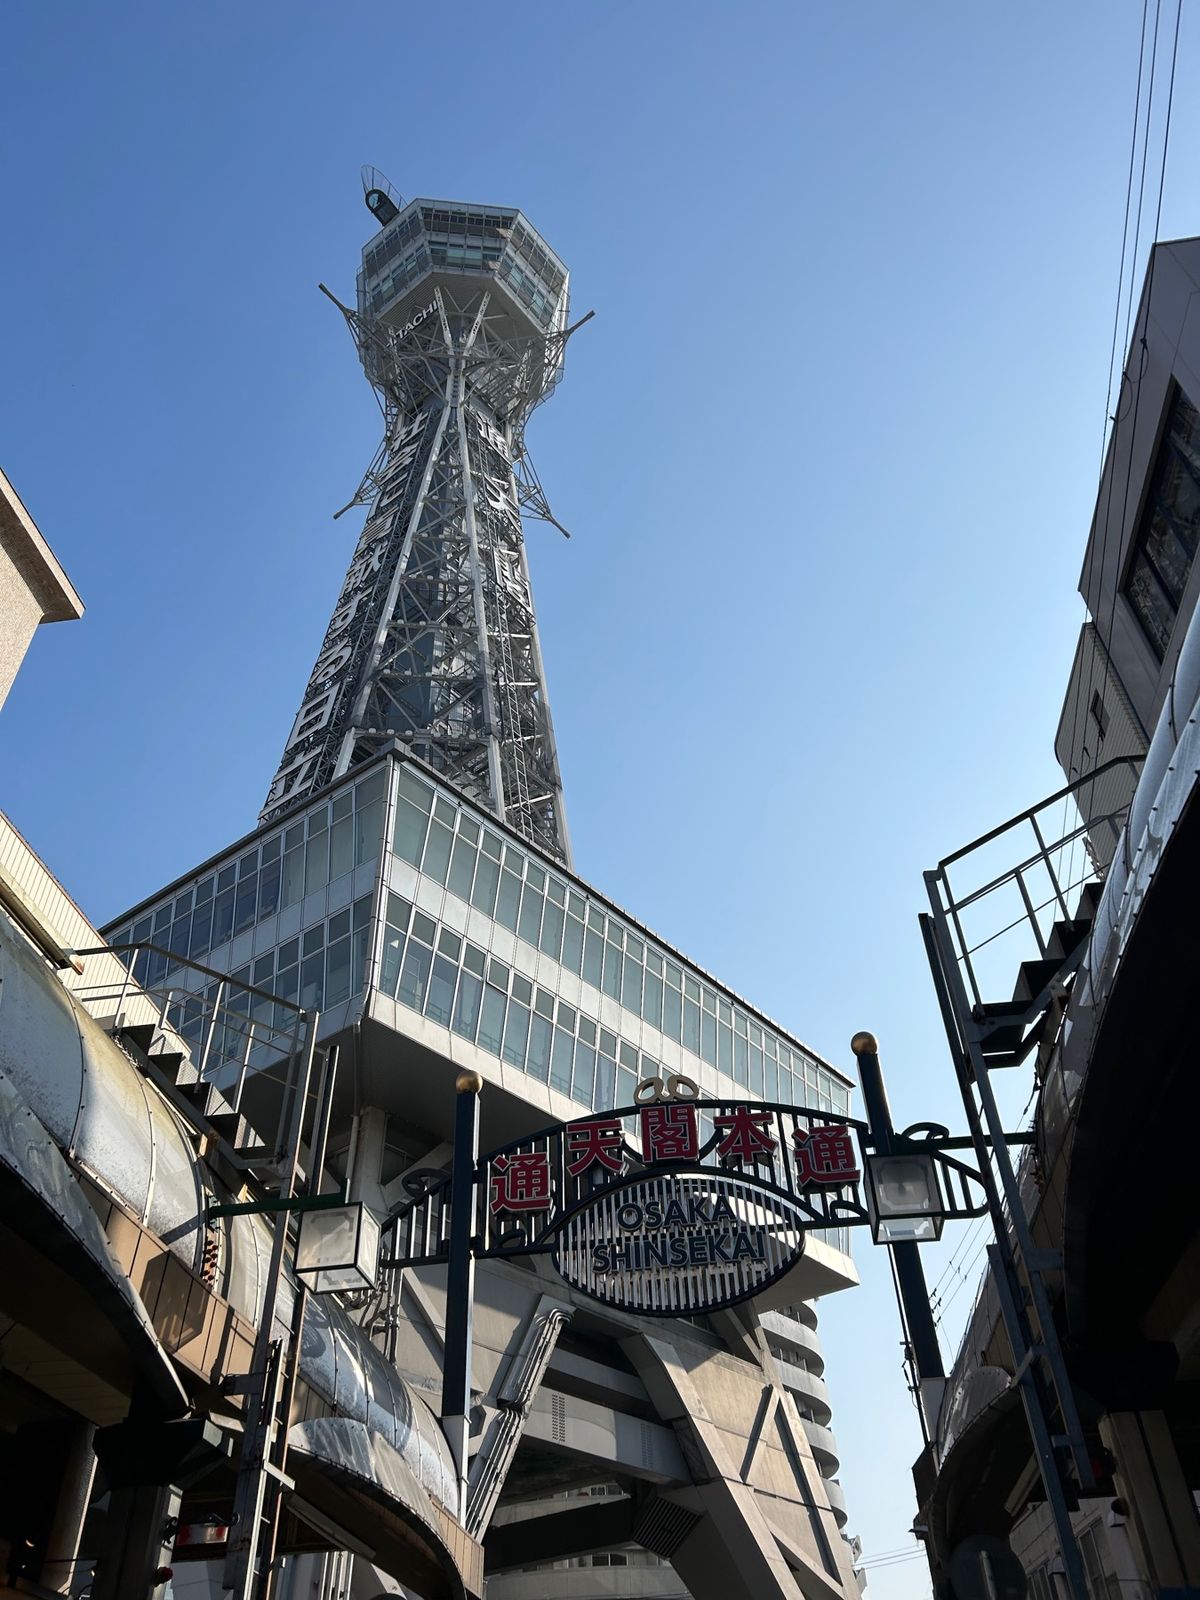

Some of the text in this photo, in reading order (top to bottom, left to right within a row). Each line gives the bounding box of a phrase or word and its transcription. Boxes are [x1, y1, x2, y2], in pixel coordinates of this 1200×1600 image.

[490, 1103, 861, 1215] 通天閣本通
[617, 1197, 737, 1232] OSAKA
[592, 1230, 766, 1273] SHINSEKAI
